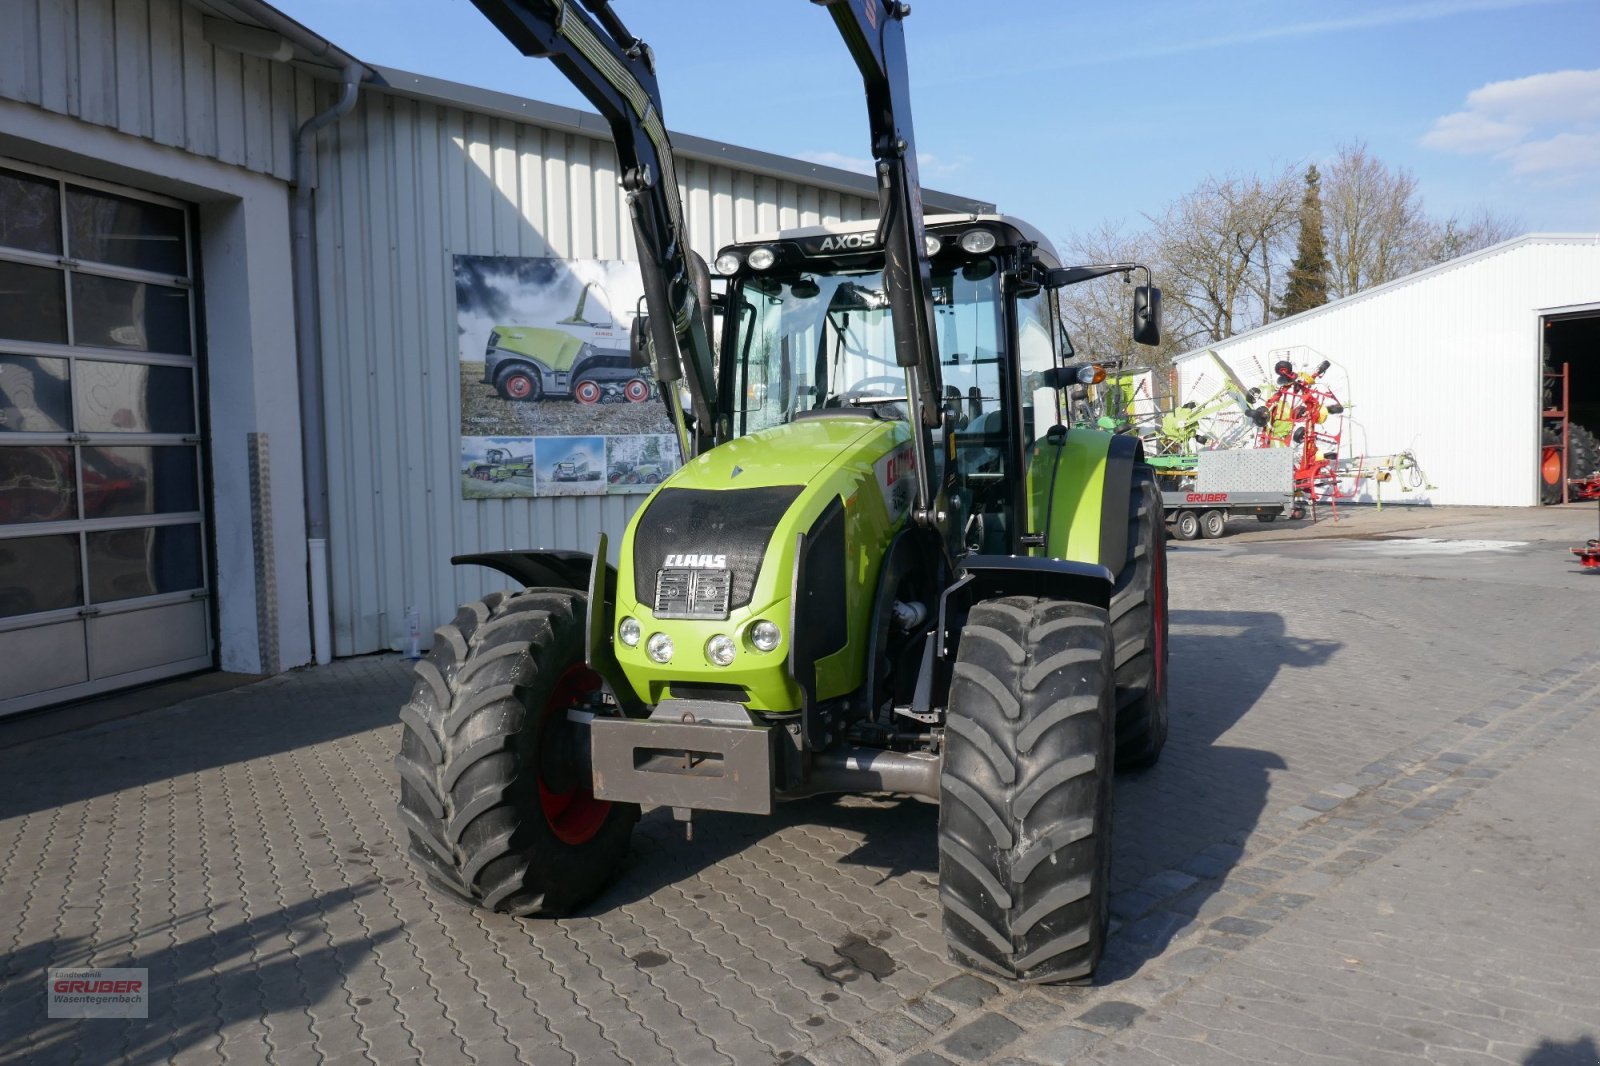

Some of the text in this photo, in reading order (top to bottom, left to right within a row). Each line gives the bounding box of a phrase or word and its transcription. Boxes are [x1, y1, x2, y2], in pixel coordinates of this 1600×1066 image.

[820, 232, 876, 251] AXOS
[1186, 493, 1228, 502] GRUBER
[663, 554, 726, 568] CLAAS
